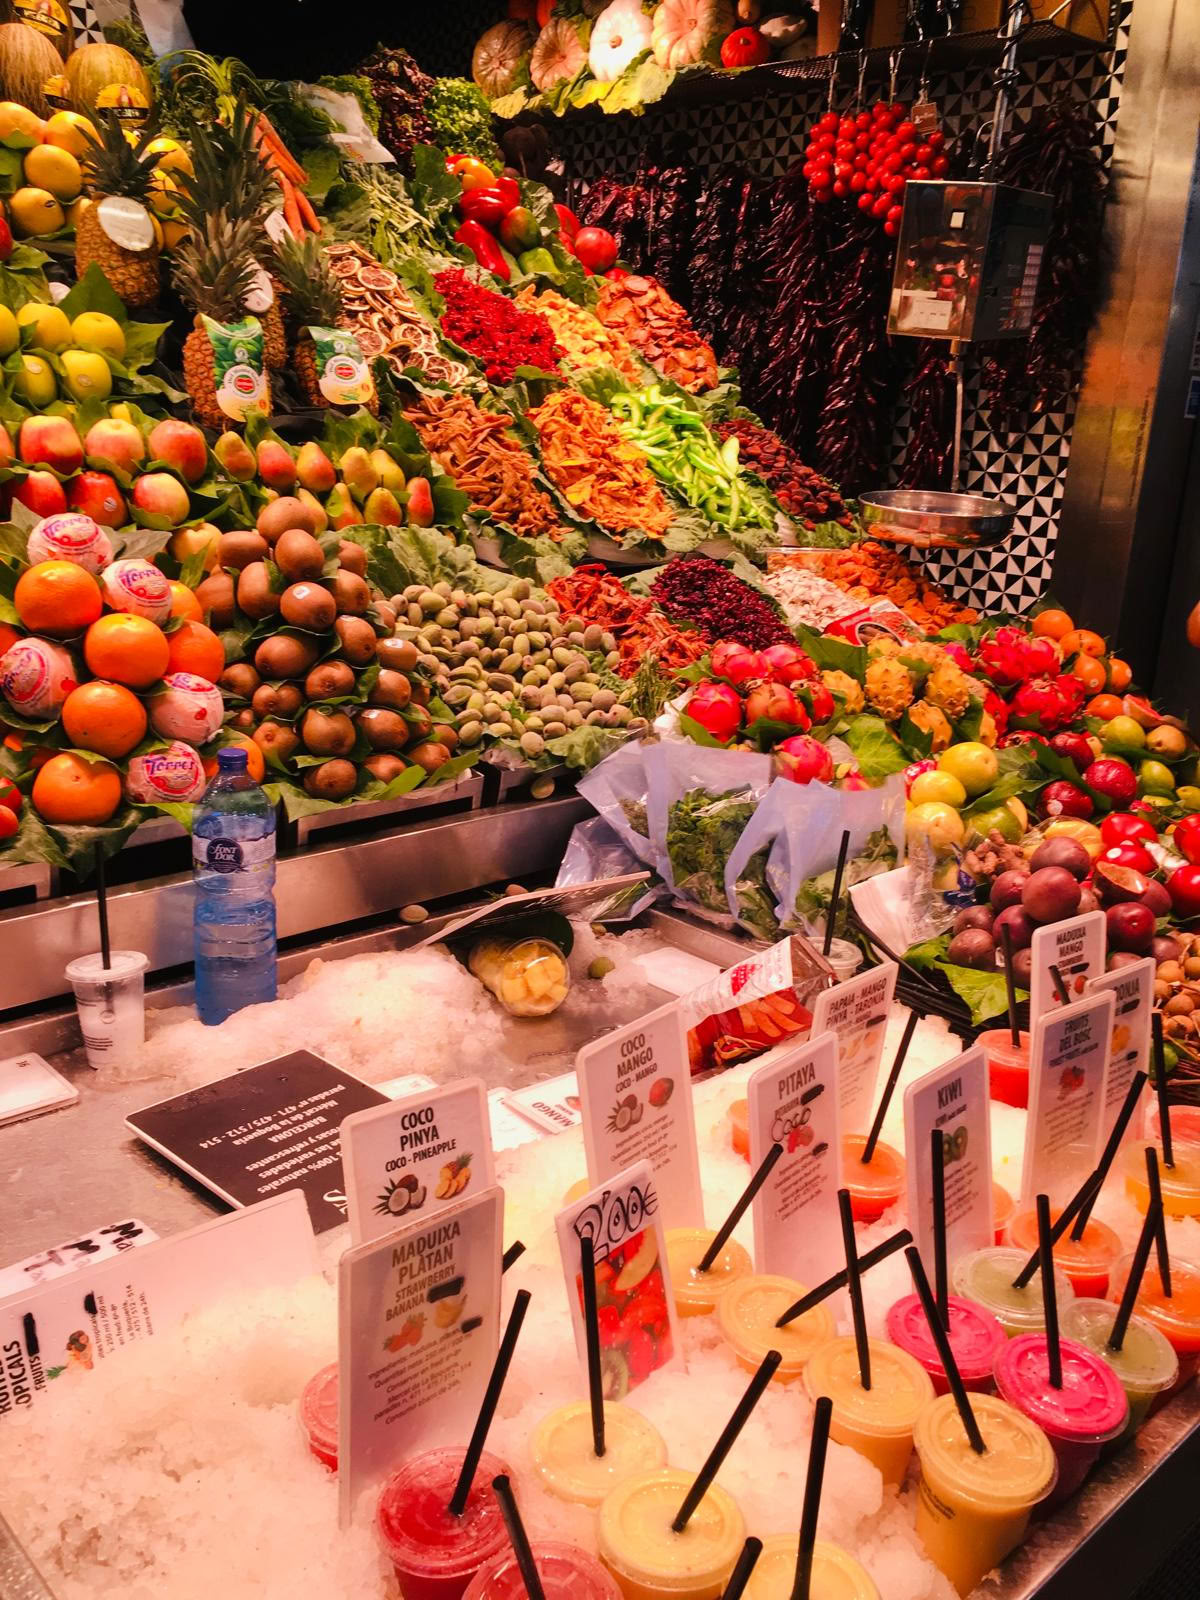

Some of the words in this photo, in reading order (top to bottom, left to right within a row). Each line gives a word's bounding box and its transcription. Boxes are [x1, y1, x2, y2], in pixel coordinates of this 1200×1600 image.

[143, 755, 196, 776] Torres
[1059, 940, 1083, 957] MANGO
[861, 977, 887, 998] MANGO
[826, 1008, 847, 1030] PINYA
[855, 990, 885, 1015] TARONJA
[621, 1033, 646, 1058] COCO
[1060, 1035, 1072, 1052] DEL
[617, 1046, 653, 1079] MANGO
[616, 1077, 631, 1093] COCO
[635, 1062, 658, 1082] MANGO
[778, 1062, 816, 1100] PITAYA
[306, 1082, 345, 1104] paradas
[937, 1077, 962, 1109] KIWI
[250, 1113, 273, 1128] 475
[276, 1102, 298, 1117] 471
[288, 1111, 304, 1124] de
[401, 1107, 434, 1131] COCO
[531, 1101, 575, 1127] MANGO
[224, 1124, 247, 1139] 512
[266, 1114, 327, 1145] BARCELONA
[277, 1117, 290, 1128] la
[197, 1135, 222, 1151] 514
[306, 1134, 316, 1144] y
[314, 1142, 331, 1155] las
[400, 1125, 440, 1152] PINYA
[244, 1138, 309, 1173] refrescantes
[257, 1148, 316, 1180] variedades
[306, 1153, 338, 1171] 100%
[385, 1157, 407, 1172] COCO
[413, 1139, 457, 1163] PINEAPPLE
[255, 1165, 309, 1195] naturales
[392, 1221, 461, 1268] MADUIXA
[395, 1263, 456, 1303] STRAWBERRY
[385, 1293, 424, 1322] BANANA
[29, 1355, 46, 1391] FRUITS
